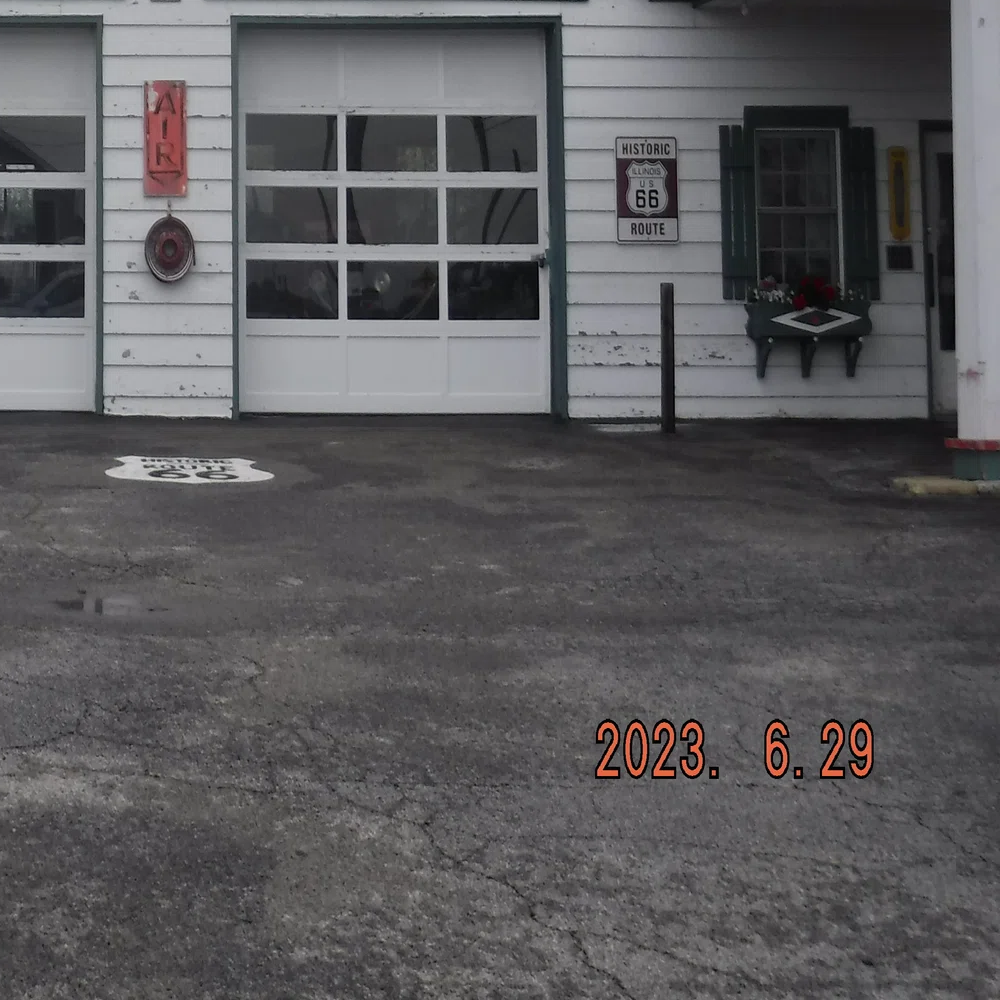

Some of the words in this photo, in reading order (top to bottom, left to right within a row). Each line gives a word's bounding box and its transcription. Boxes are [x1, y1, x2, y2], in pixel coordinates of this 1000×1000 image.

[153, 91, 177, 166] AIR
[622, 143, 670, 155] HISTORIC
[632, 167, 662, 175] ILLINOIS
[635, 189, 659, 208] 66
[631, 222, 665, 235] ROUTE
[148, 469, 239, 480] 66
